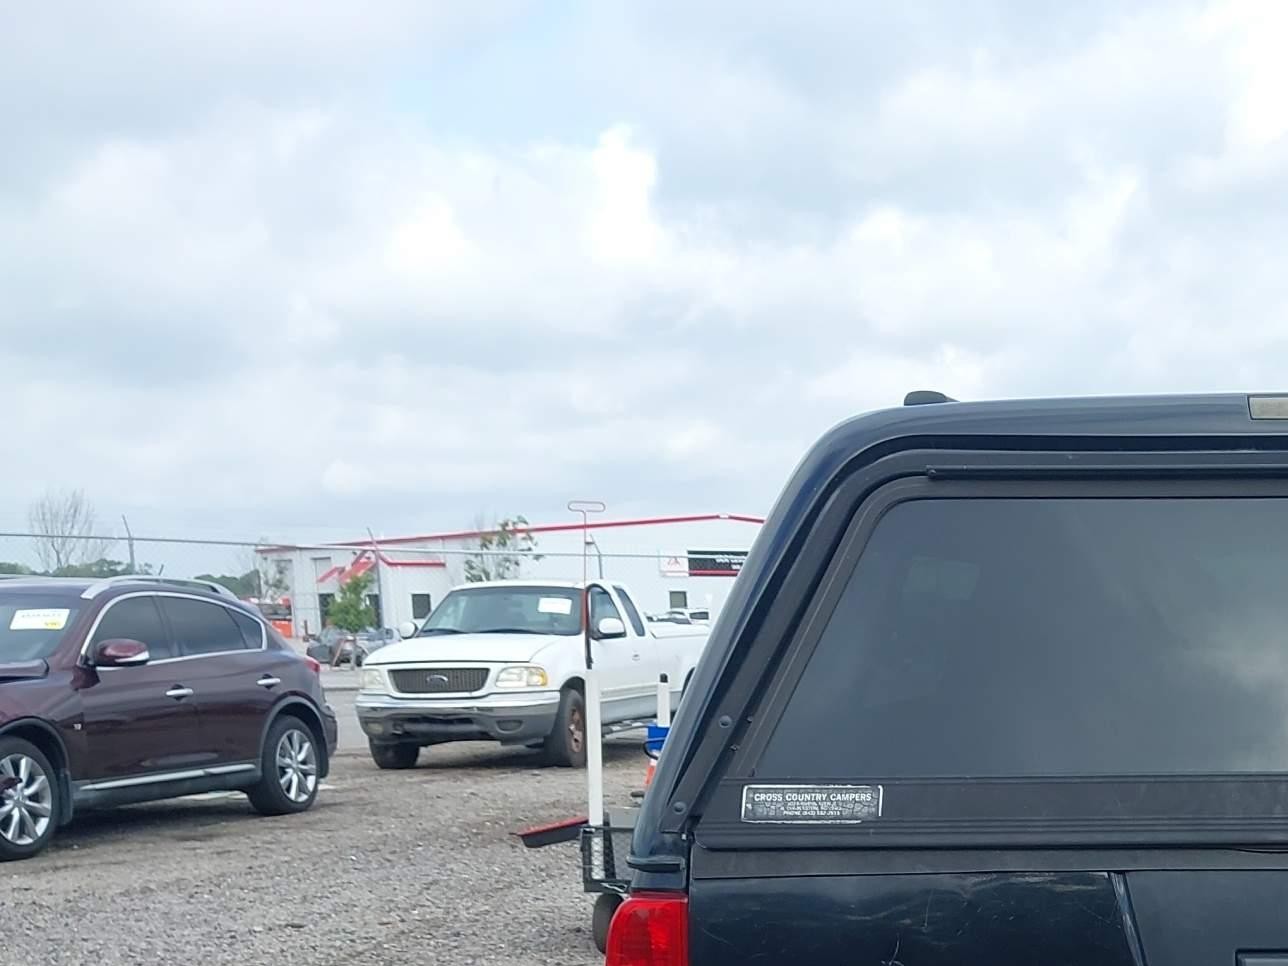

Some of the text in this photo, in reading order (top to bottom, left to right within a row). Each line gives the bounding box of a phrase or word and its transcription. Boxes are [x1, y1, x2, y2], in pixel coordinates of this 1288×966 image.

[754, 793, 872, 801] CROSS COUNTRY CAMPERS
